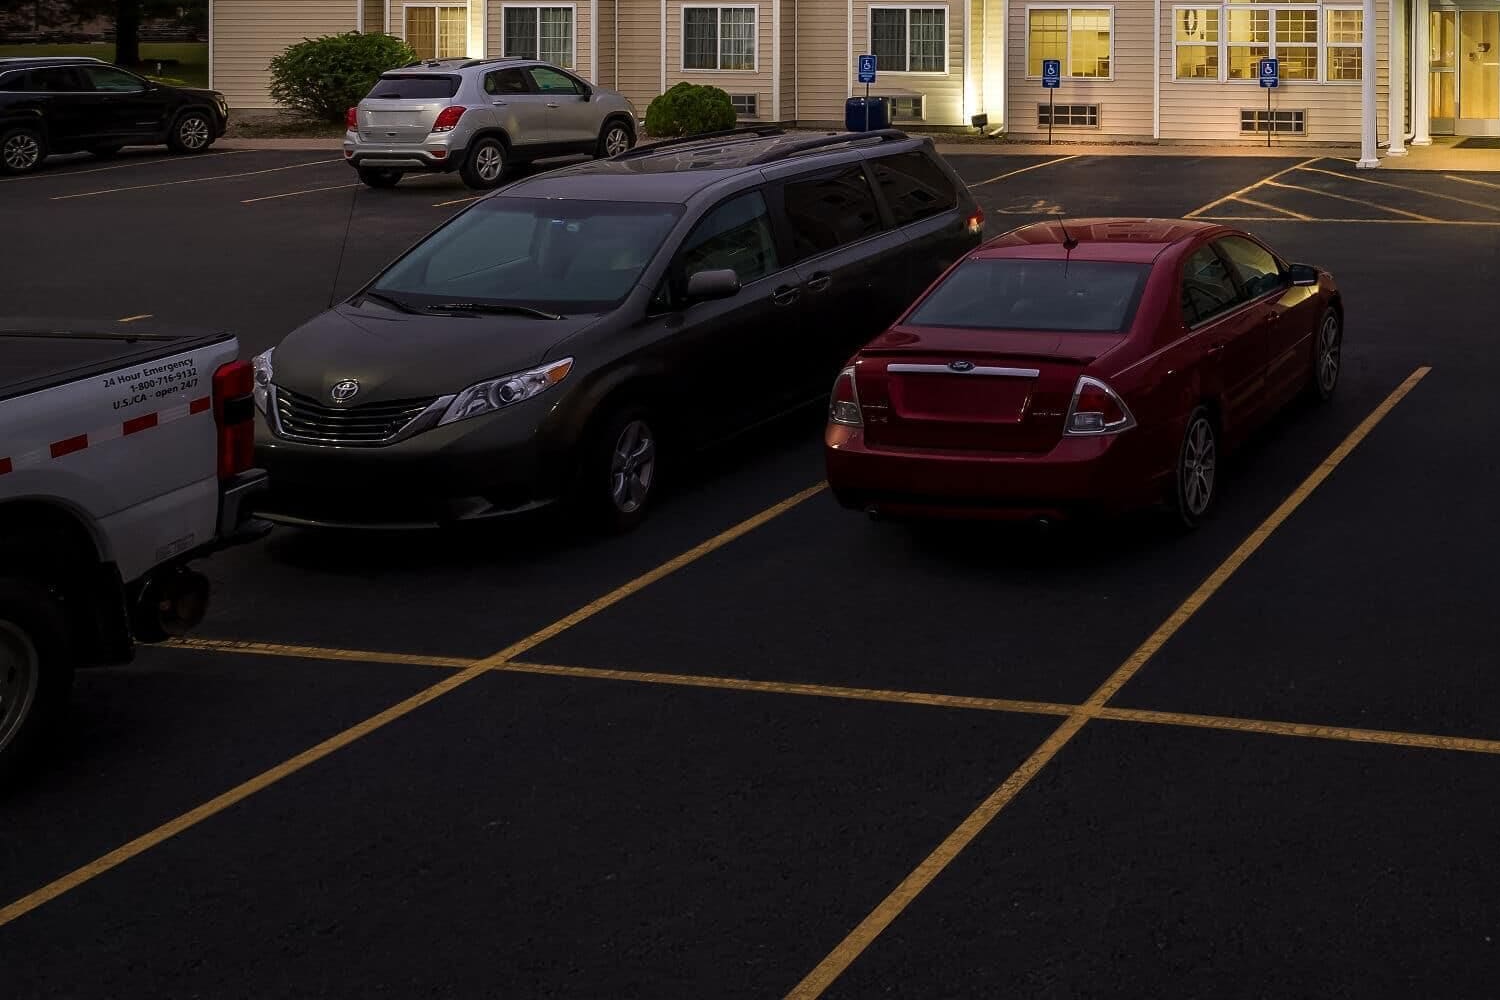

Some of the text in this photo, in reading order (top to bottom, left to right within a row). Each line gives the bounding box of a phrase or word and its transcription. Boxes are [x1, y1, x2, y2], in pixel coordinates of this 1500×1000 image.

[103, 358, 194, 388] 24 Hour Emergency
[130, 367, 198, 393] 1-800-716-9132
[113, 394, 148, 410] U.S./CA
[155, 385, 179, 399] open
[181, 378, 199, 391] 24/7
